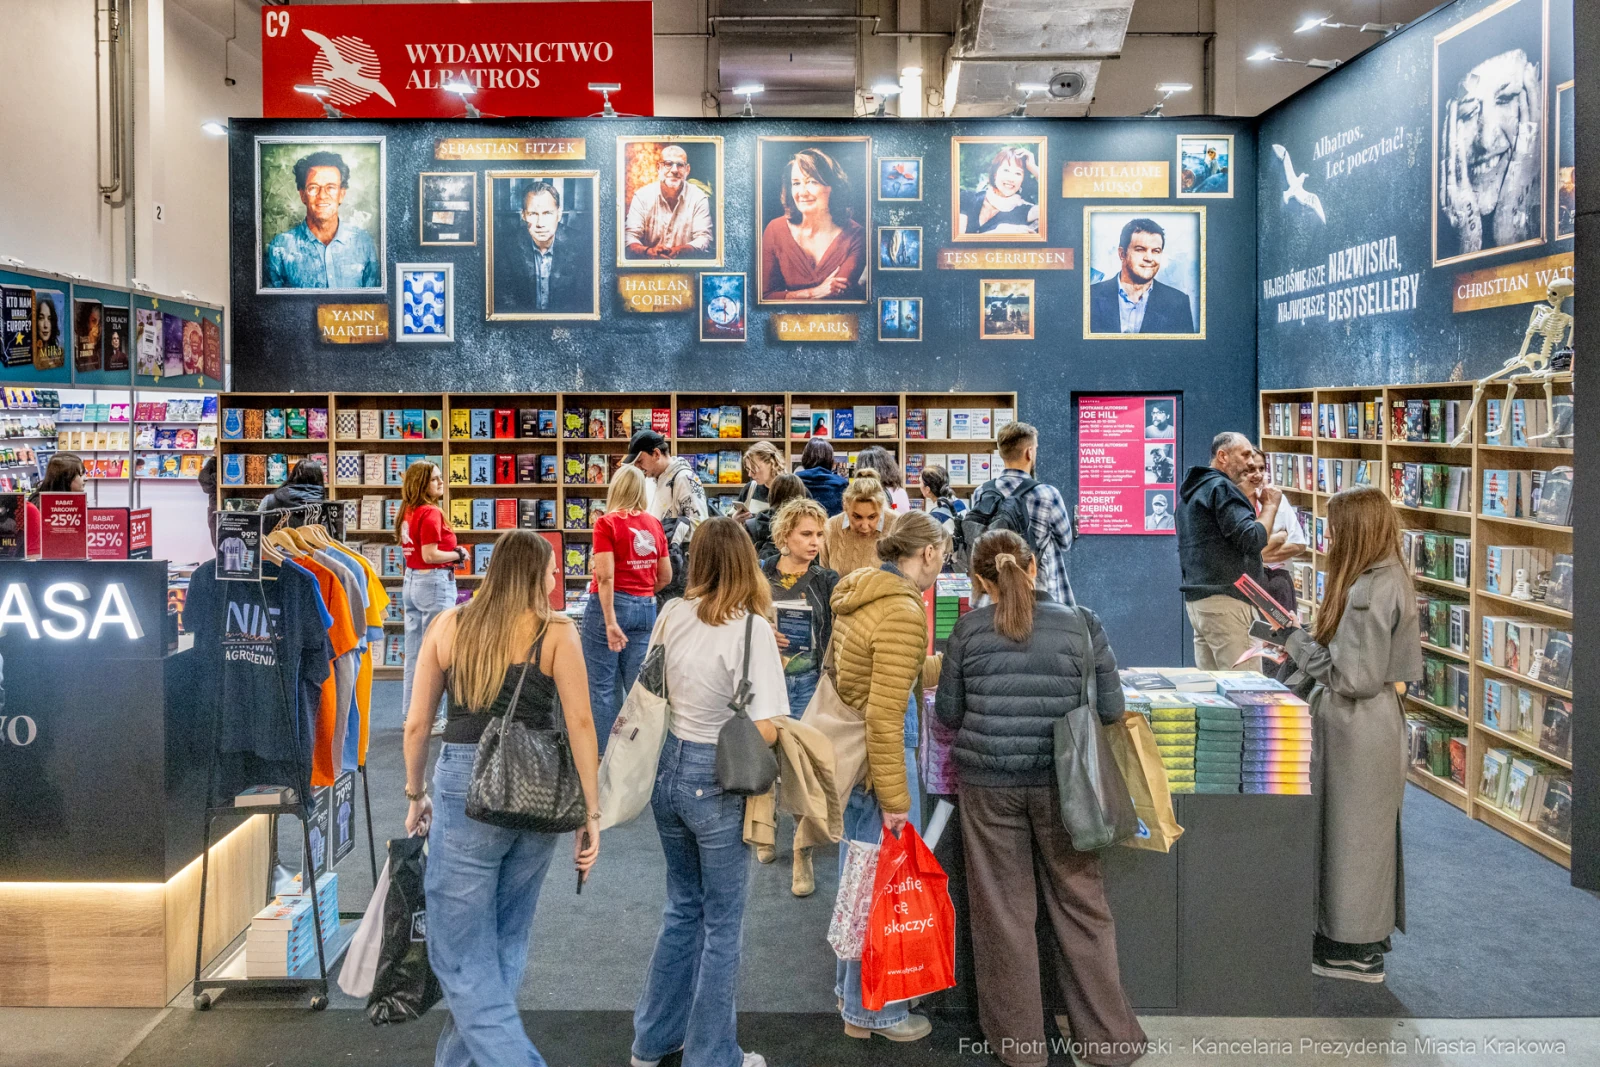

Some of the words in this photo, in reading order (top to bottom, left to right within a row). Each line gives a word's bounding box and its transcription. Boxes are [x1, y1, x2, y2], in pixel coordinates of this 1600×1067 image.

[266, 11, 290, 37] C9
[405, 42, 613, 64] WYDAWNICTWO
[405, 68, 540, 90] ALBATROS
[440, 142, 519, 155] SEBASTIAN
[526, 141, 576, 154] FITZEK
[1313, 126, 1364, 160] Albatros.
[1326, 156, 1345, 179] Leć
[1347, 127, 1404, 174] poczytać!
[1073, 166, 1163, 178] GUILLAUME
[1093, 181, 1144, 192] MUSSO
[156, 205, 162, 220] 2
[944, 252, 980, 264] TESS
[985, 252, 1066, 264] GERRITSEN
[1263, 265, 1326, 299] NAJGŁOŚNIEJSZE
[1329, 236, 1401, 284] NAZWISKA,
[625, 279, 689, 293] HARLAN
[1458, 273, 1528, 299] CHRISTIAN
[1535, 266, 1576, 287] WAT
[631, 291, 683, 305] COBEN
[1277, 294, 1326, 325] NAJWIĘKSZE
[1328, 273, 1420, 323] BESTSELLERY
[332, 310, 375, 323] YANN
[323, 323, 384, 337] MARTEL
[780, 320, 804, 333] B.A.
[809, 319, 849, 333] PARIS
[1080, 411, 1096, 419] JOE
[1098, 411, 1118, 419] HILL
[1080, 448, 1105, 456] YANN
[1080, 456, 1117, 464] MARTEL
[1080, 496, 1115, 504] ROBERT
[1080, 502, 1123, 514] ZIĘBIŃSKI
[131, 521, 147, 534] 3+1
[0, 582, 140, 640] ASA
